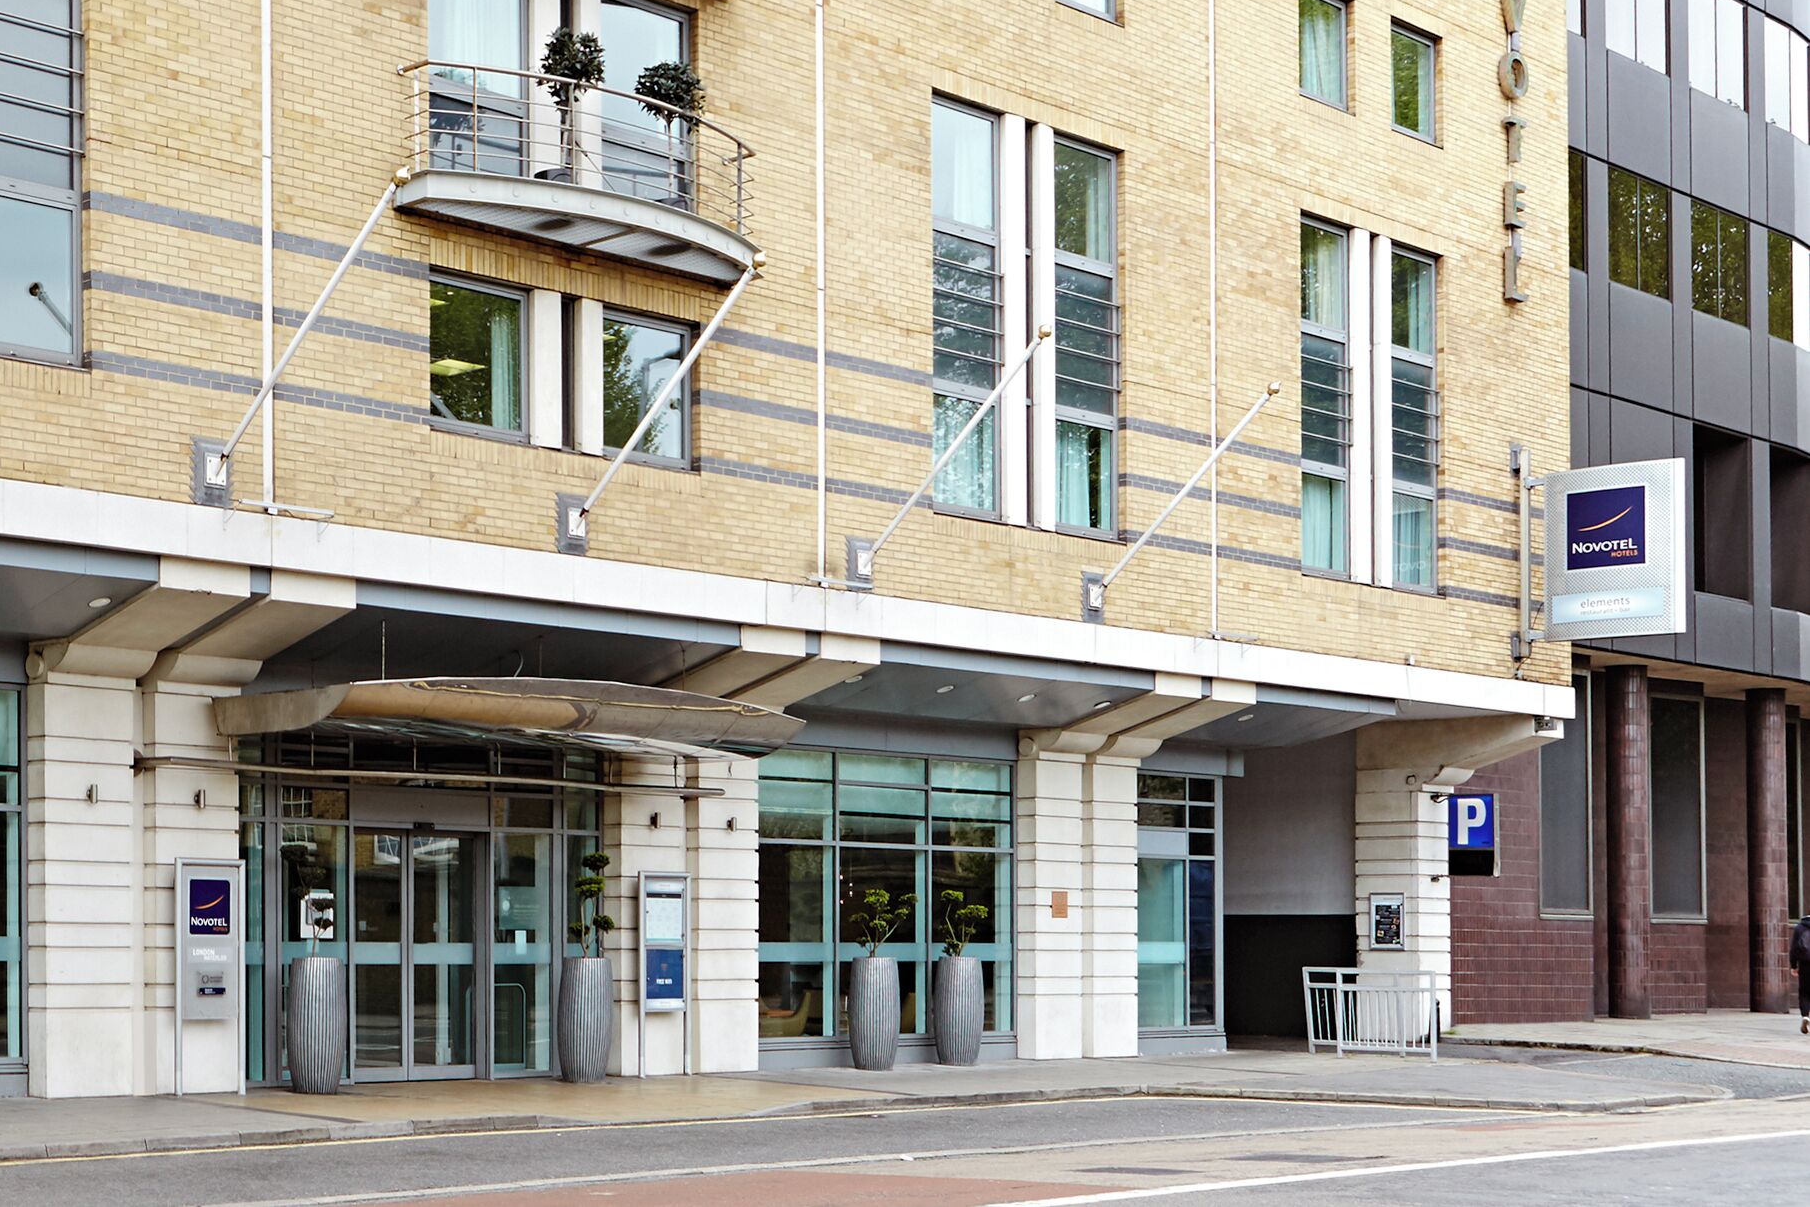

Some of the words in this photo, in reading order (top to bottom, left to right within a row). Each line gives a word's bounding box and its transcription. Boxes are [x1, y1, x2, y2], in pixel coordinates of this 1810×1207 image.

[1572, 538, 1638, 554] NOVOTEL
[1610, 549, 1638, 558] HOTELS
[1580, 597, 1631, 609] elements
[1457, 798, 1487, 845] P
[191, 916, 228, 926] NOVOTEL
